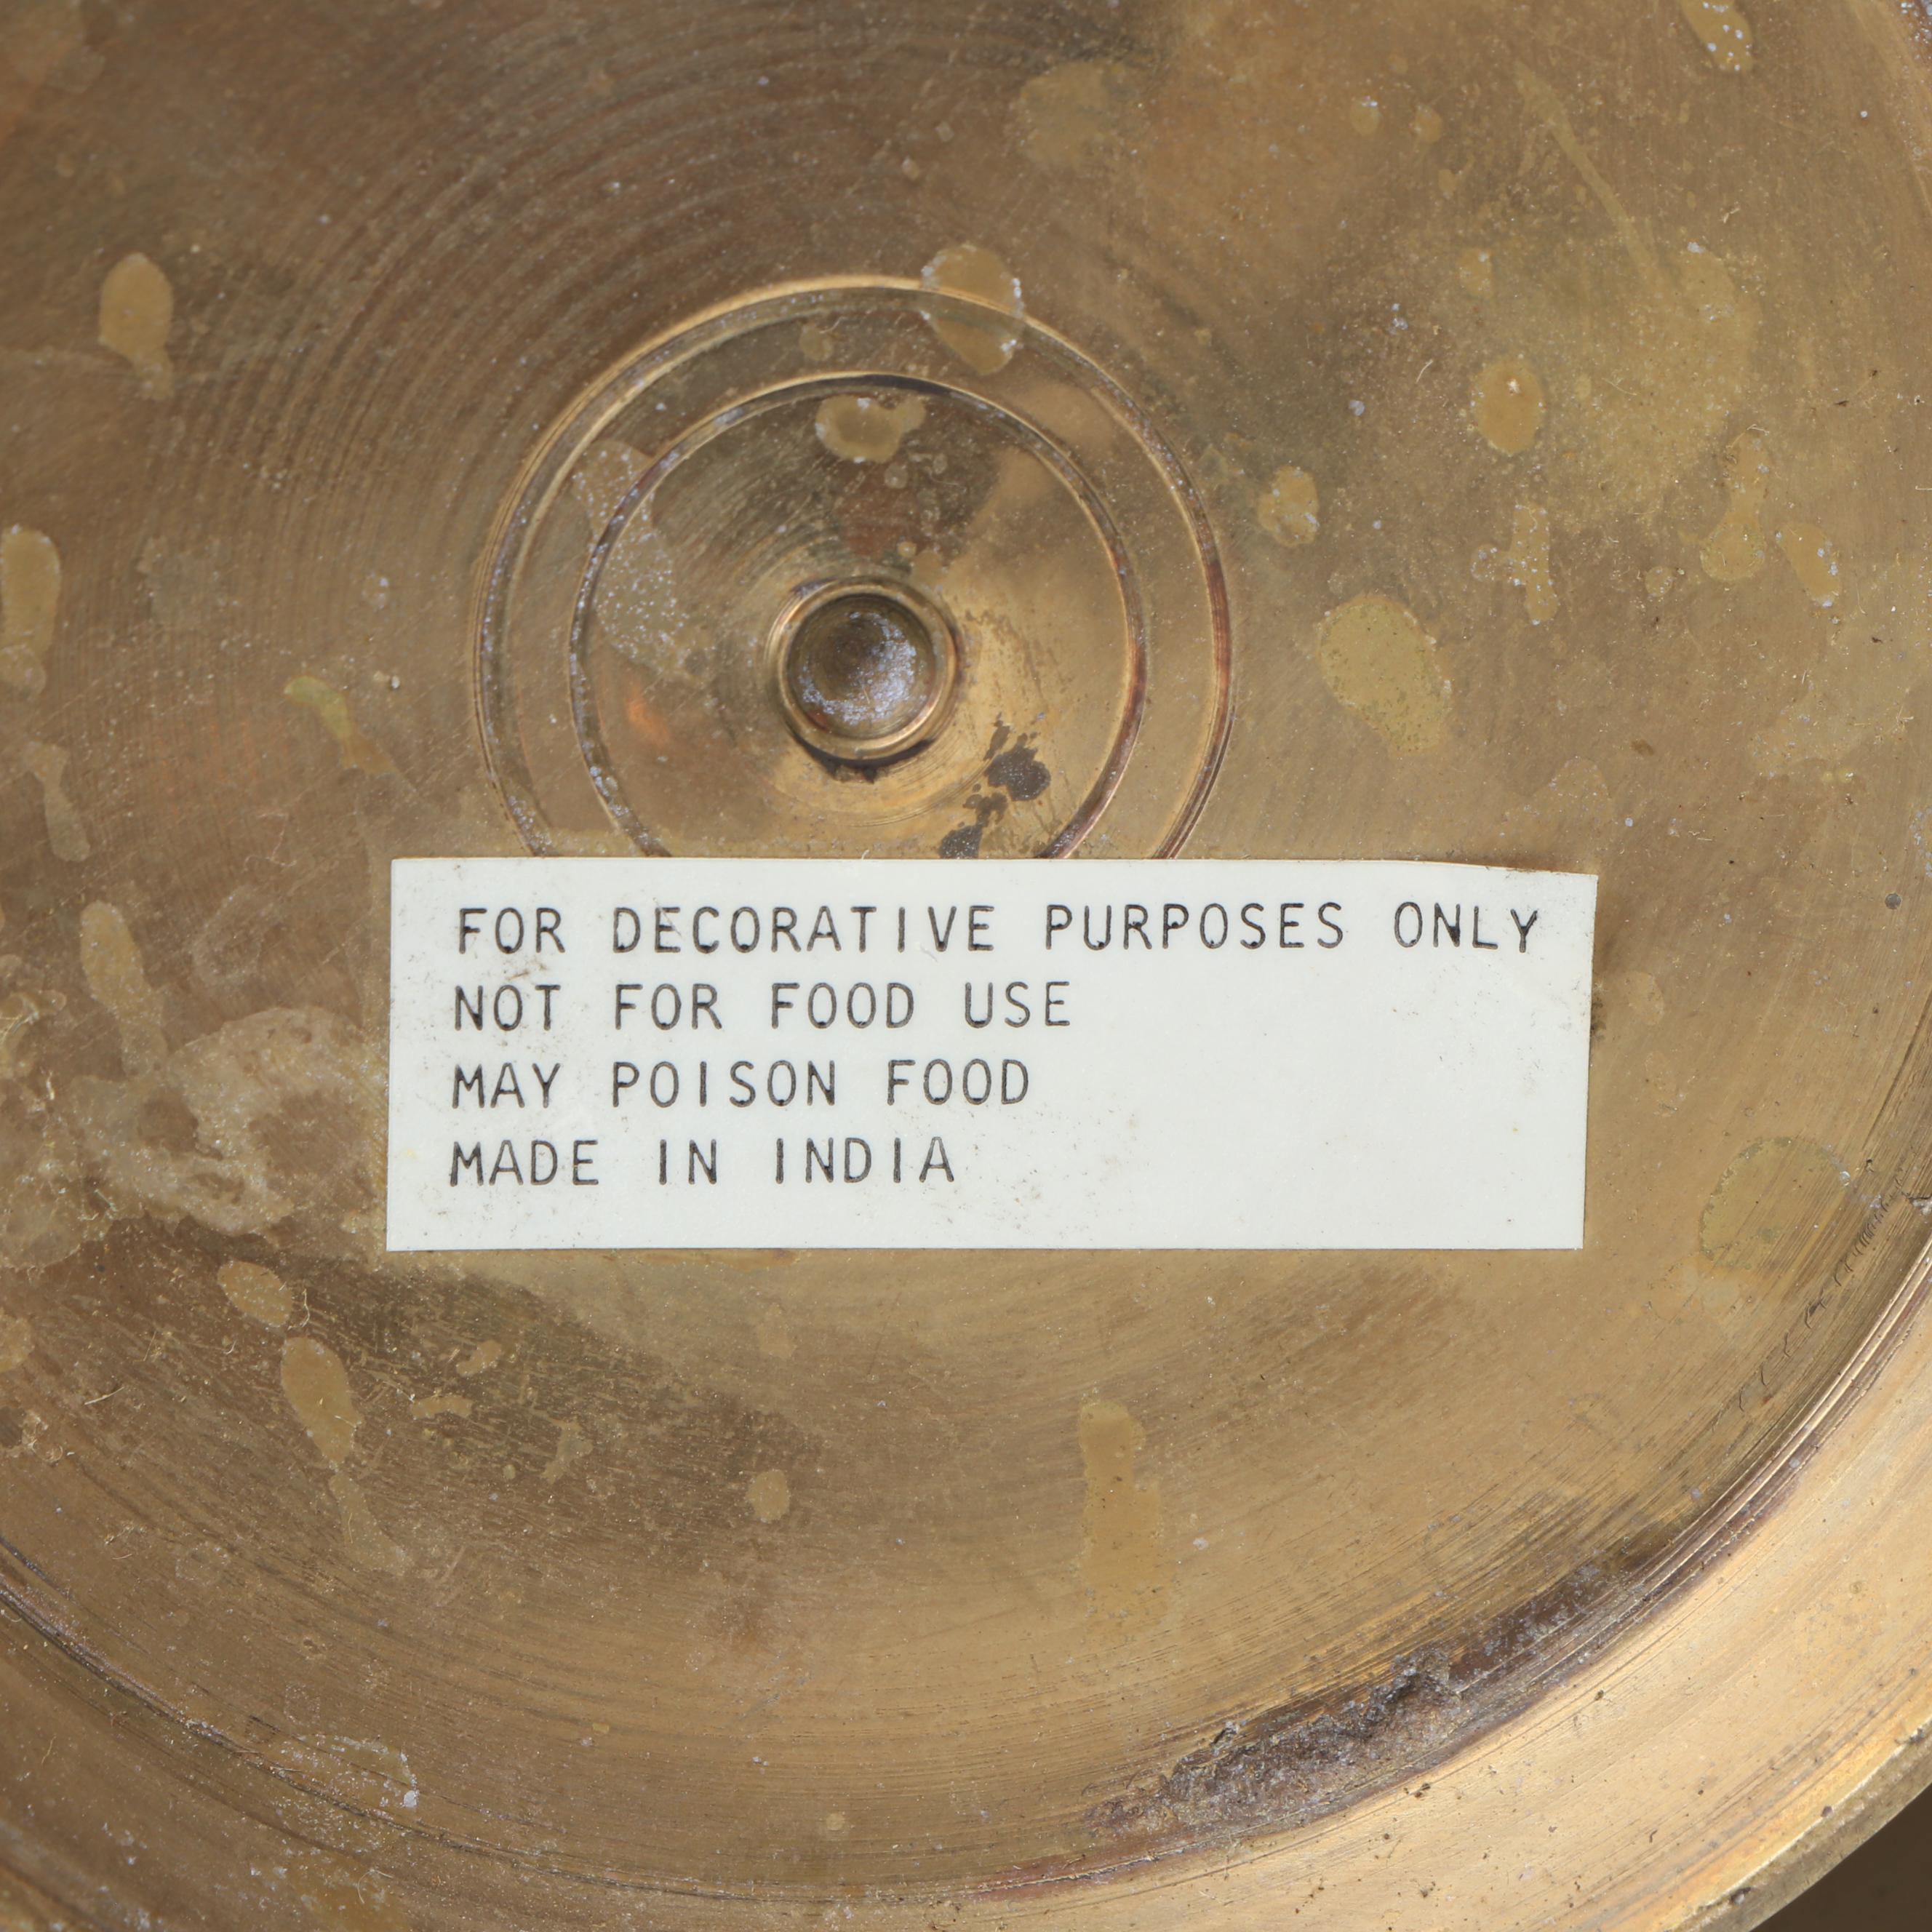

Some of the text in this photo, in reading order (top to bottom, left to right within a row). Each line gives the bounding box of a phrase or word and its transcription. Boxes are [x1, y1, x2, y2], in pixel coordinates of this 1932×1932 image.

[459, 901, 1538, 954] FOR DECORATIVE PURPOSES ONLY
[455, 981, 1070, 1031] NOT FOR FOOD USE
[452, 1058, 1029, 1109] MAY POISON FOOD
[450, 1137, 955, 1187] MADE IN INDIA
